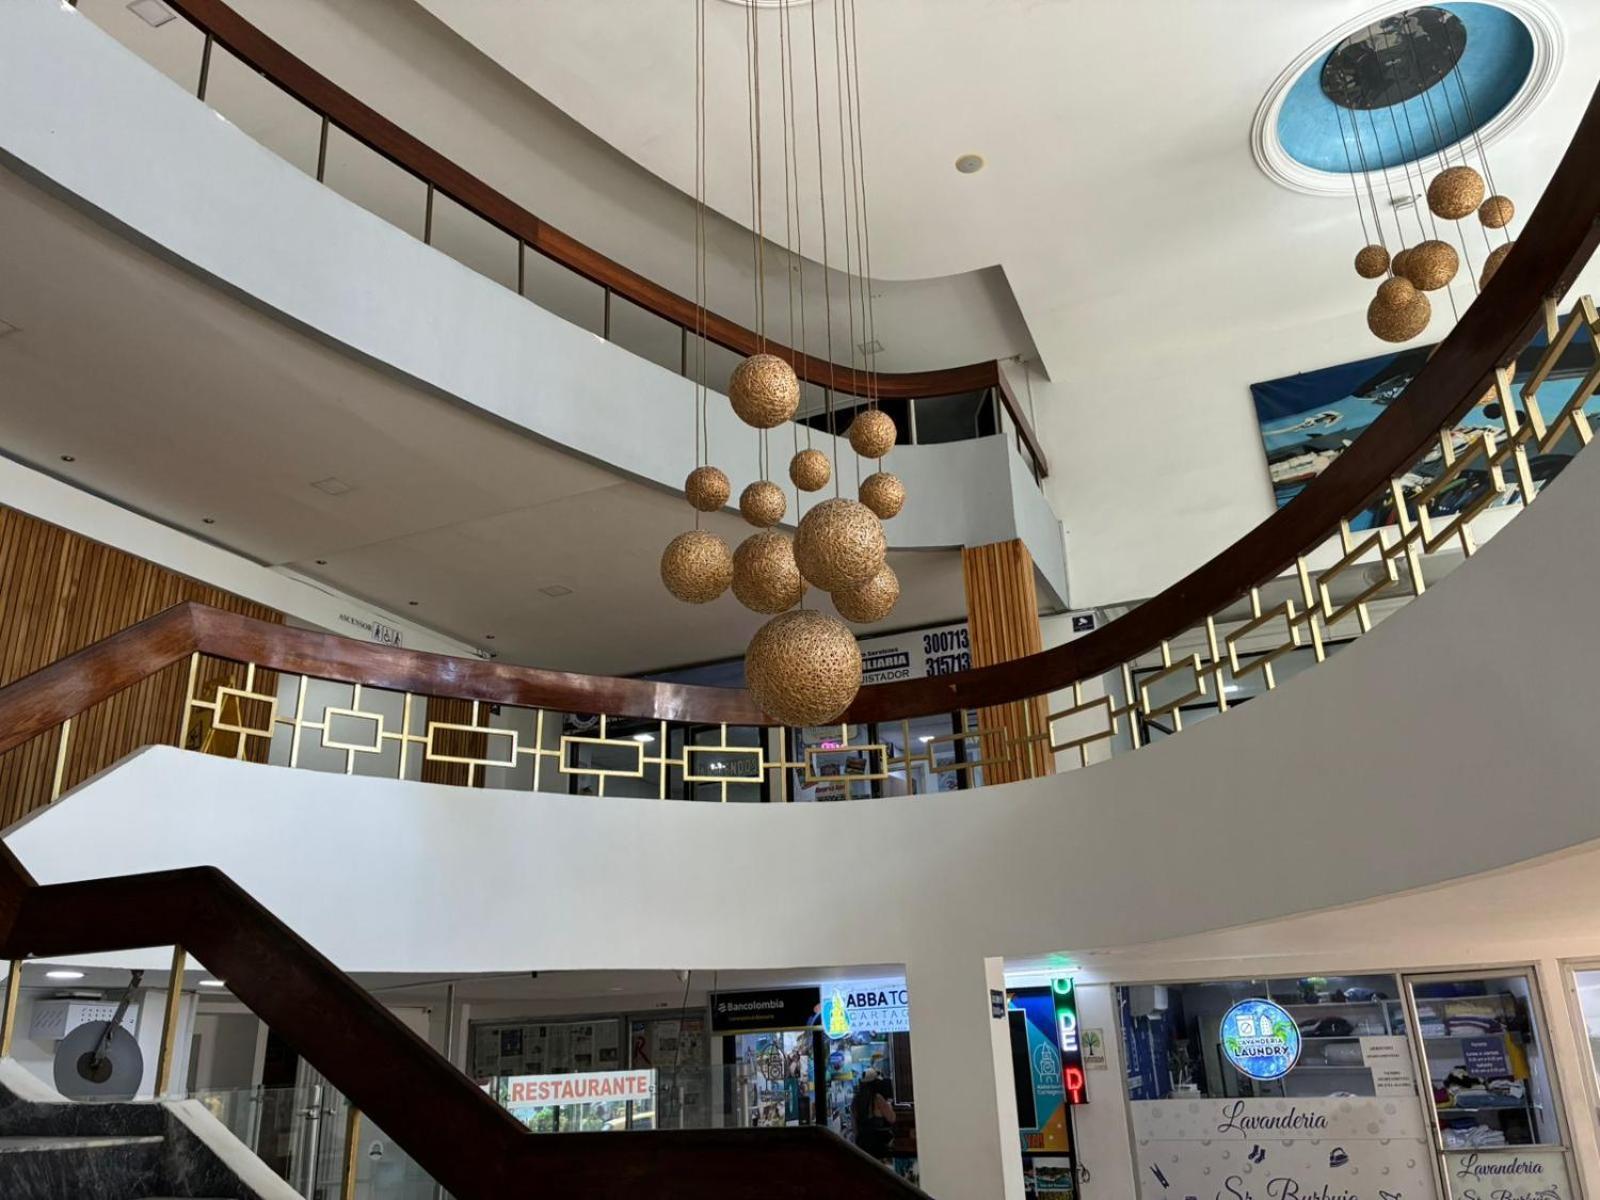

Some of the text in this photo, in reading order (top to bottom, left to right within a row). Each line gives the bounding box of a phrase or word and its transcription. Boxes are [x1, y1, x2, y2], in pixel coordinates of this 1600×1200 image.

[923, 628, 970, 654] 300713
[862, 655, 908, 670] ILIARIA
[727, 1000, 785, 1012] Bancolombia
[846, 991, 889, 1008] ABBA
[1234, 1046, 1289, 1058] LAUNDRY
[511, 1075, 648, 1102] RESTAURANTE
[1217, 1099, 1329, 1139] Lavanderia
[1456, 1153, 1545, 1182] Lavanderia
